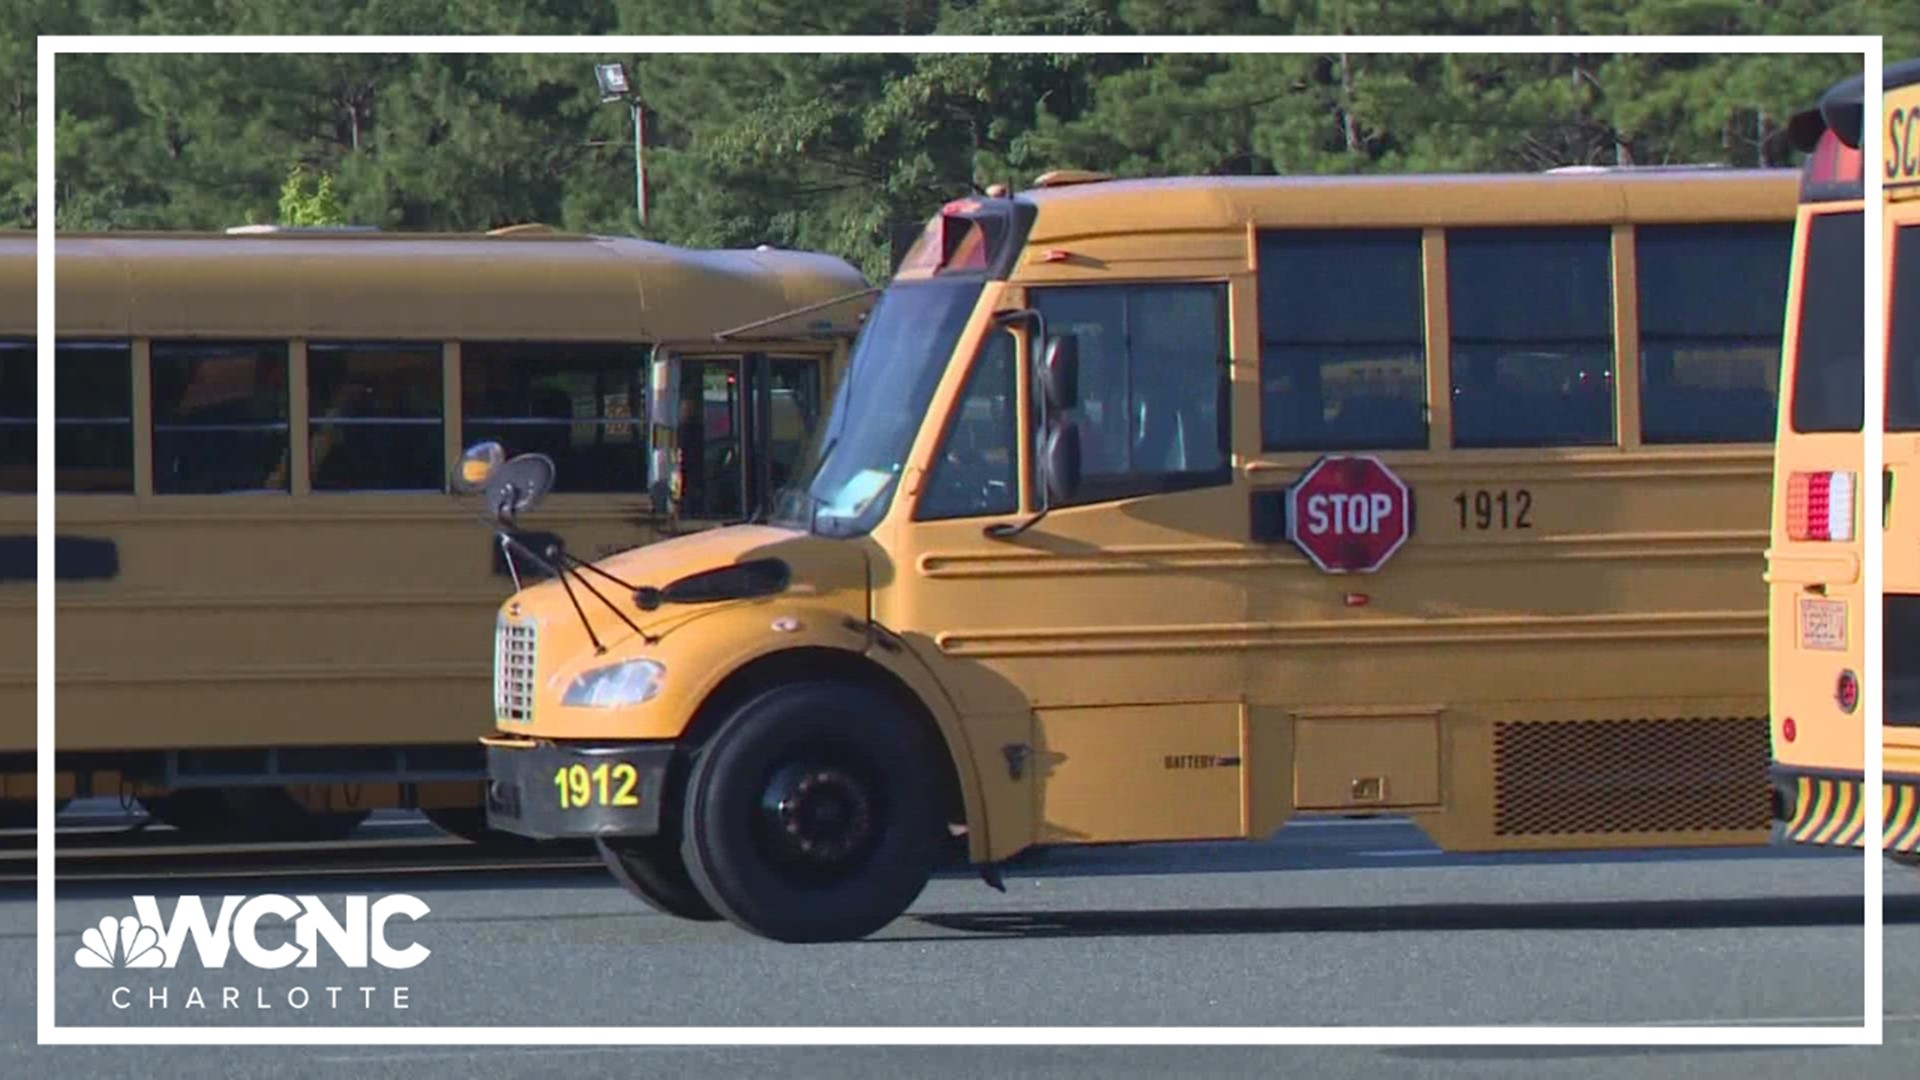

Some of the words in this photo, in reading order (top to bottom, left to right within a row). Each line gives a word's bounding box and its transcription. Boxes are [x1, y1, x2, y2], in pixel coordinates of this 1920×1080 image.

[1308, 493, 1393, 535] STOP
[1454, 489, 1533, 531] 1912
[1164, 755, 1216, 769] BATTERY
[554, 763, 639, 810] 1912
